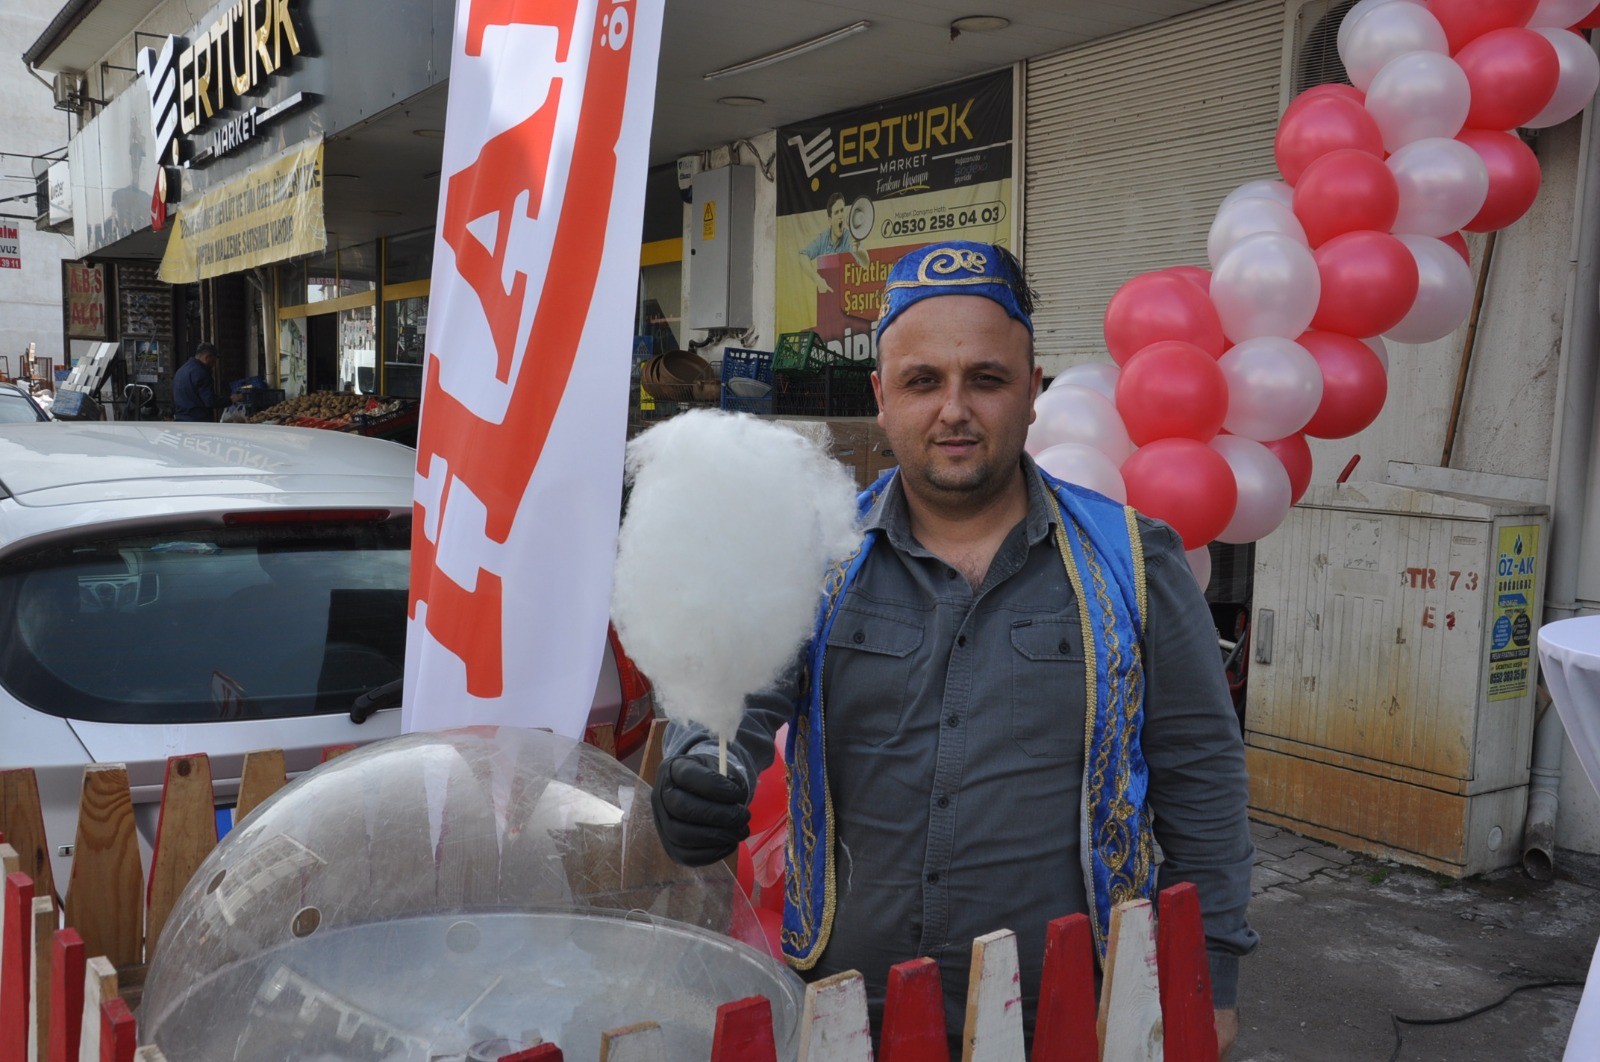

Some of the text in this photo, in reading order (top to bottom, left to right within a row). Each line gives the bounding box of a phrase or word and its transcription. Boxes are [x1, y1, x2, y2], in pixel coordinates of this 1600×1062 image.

[179, 0, 301, 135] ERTÜRK
[214, 106, 257, 158] MARKET
[839, 97, 975, 166] ERTÜRK
[880, 154, 928, 174] MARKET
[892, 206, 1000, 235] 0530 258 04 03
[0, 245, 18, 255] VUZ
[70, 267, 103, 294] A.B.S
[844, 290, 885, 315] Şaşırt
[1498, 553, 1535, 577] ÖZ-AK
[1406, 567, 1436, 590] TR
[1498, 578, 1532, 592] DOĞALGAZ
